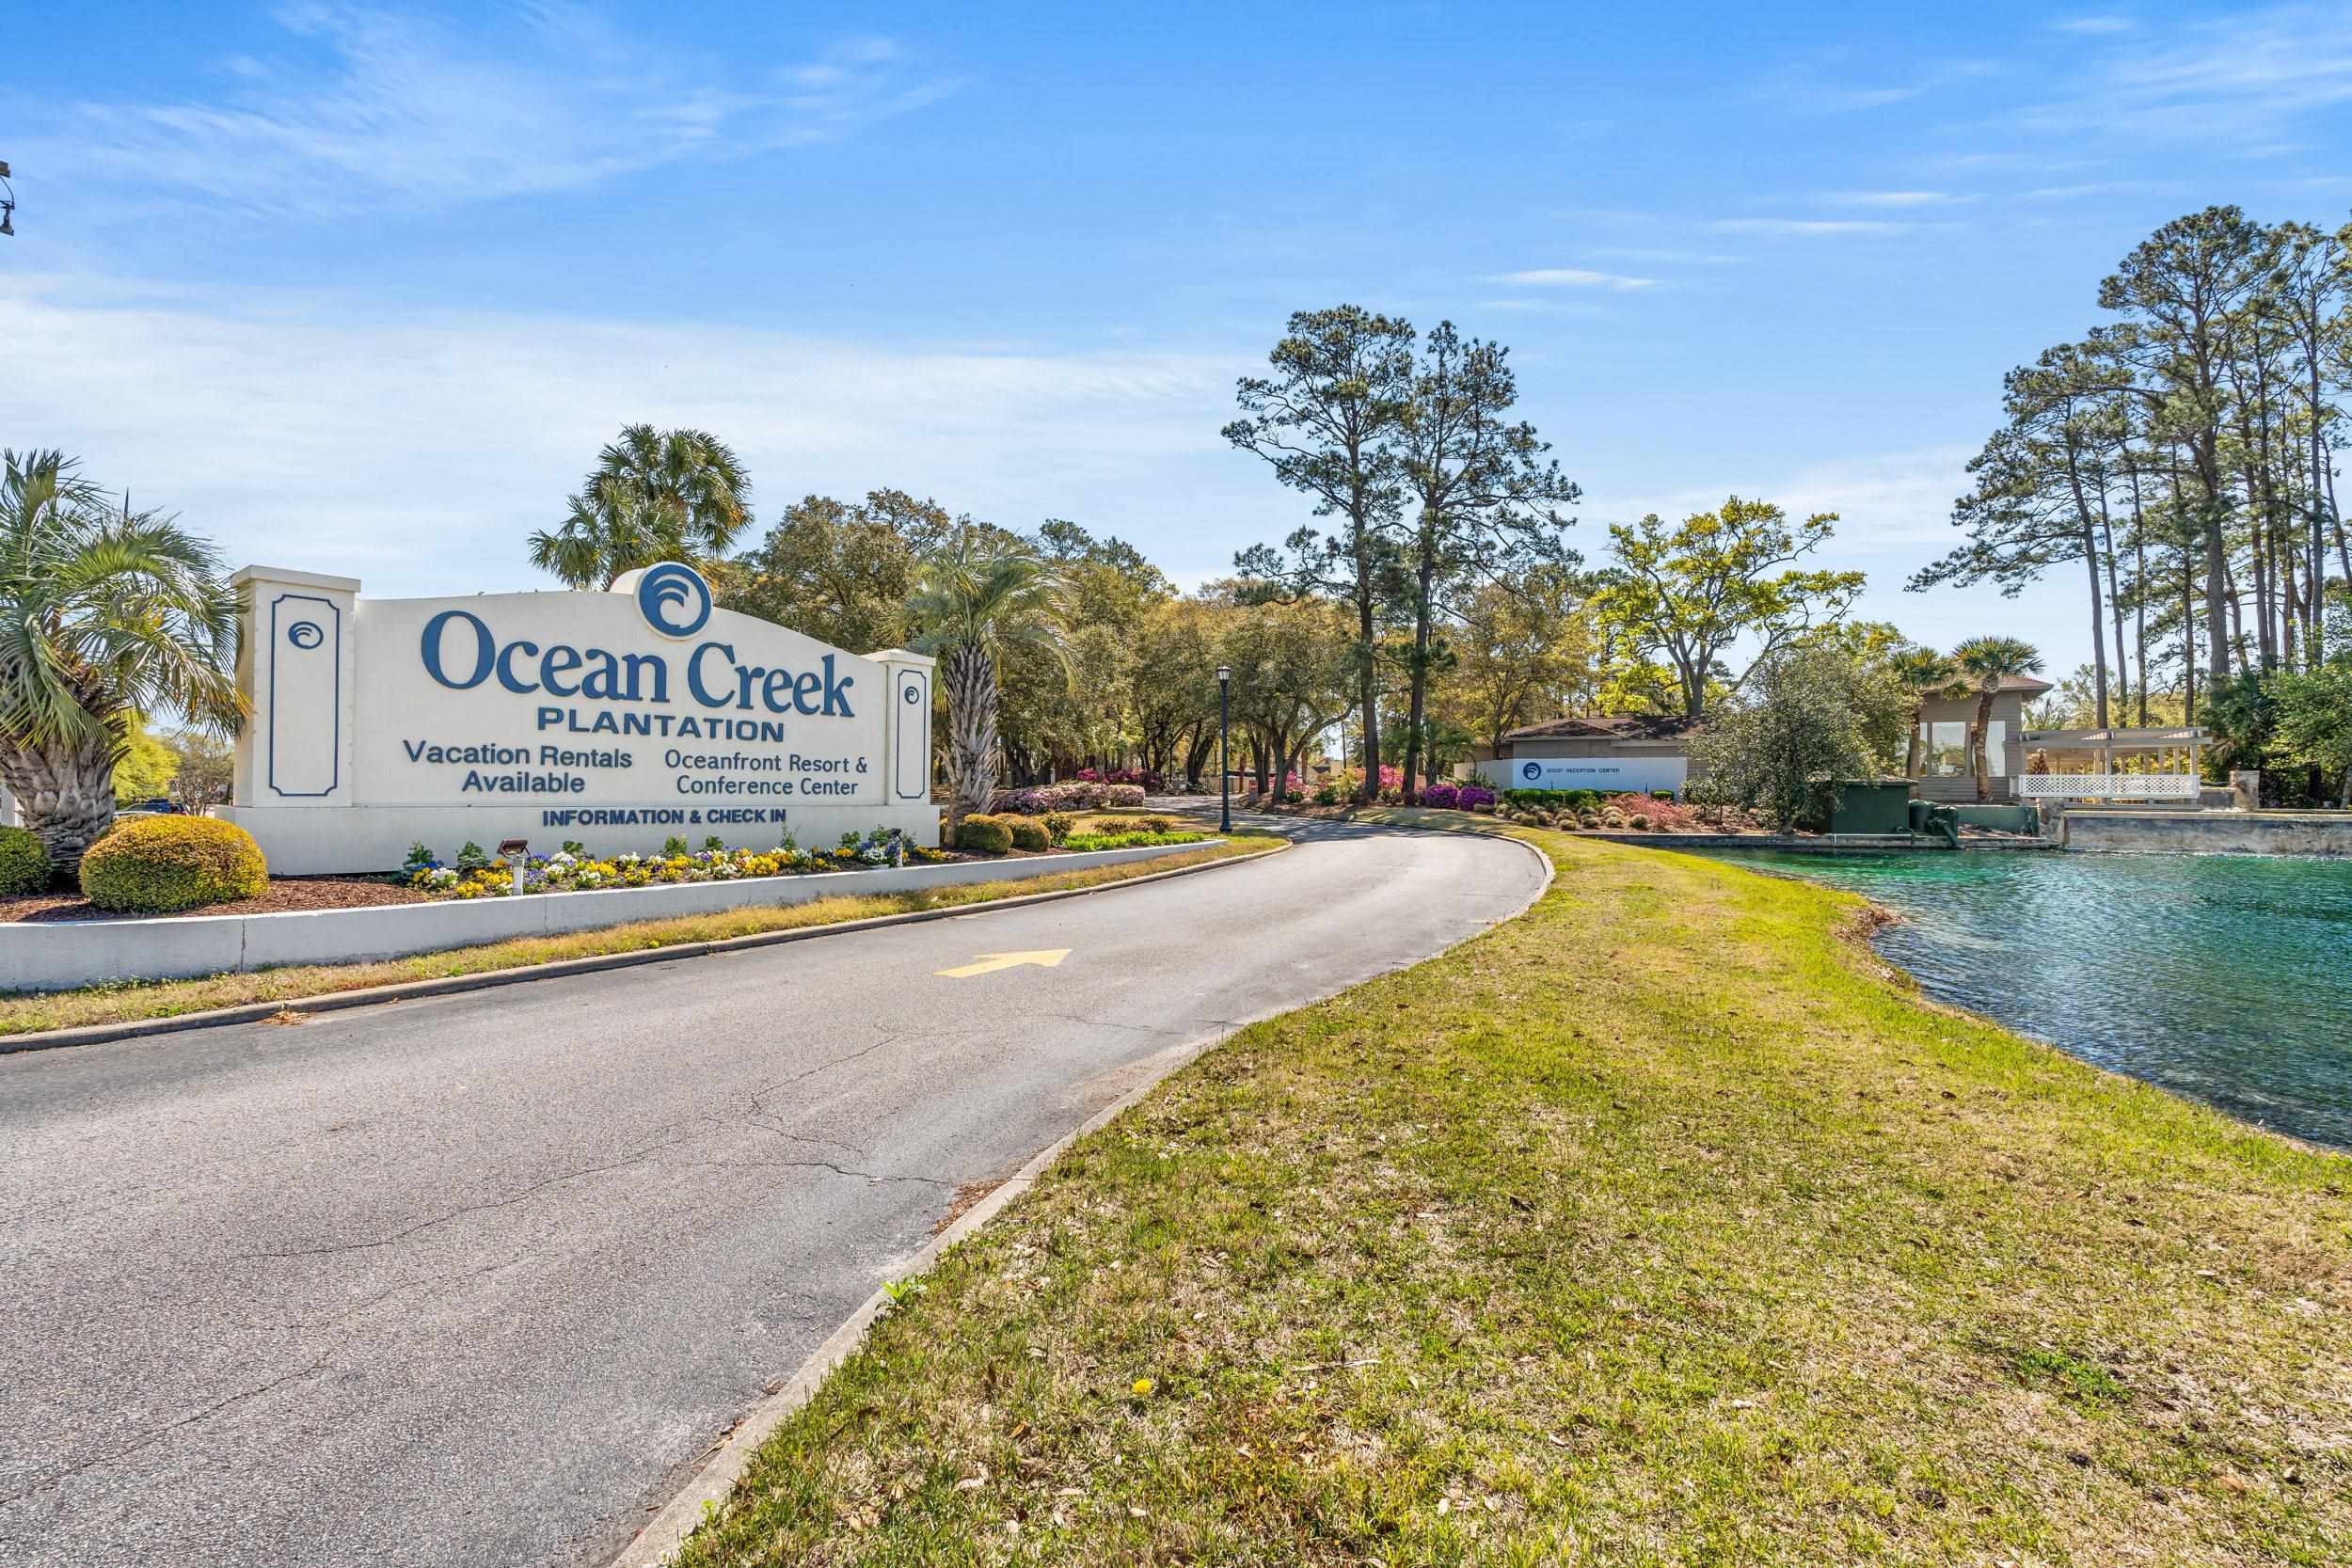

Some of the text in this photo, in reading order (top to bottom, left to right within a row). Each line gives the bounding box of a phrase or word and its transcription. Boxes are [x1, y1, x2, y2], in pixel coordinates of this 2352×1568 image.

[421, 610, 854, 719] Ocean Creek
[537, 707, 785, 743] PLANTATION
[403, 739, 633, 768] Vacation Rentals
[664, 749, 867, 774] Oceanfront Resort &
[461, 769, 586, 794] Available
[676, 774, 859, 796] Conference Center
[542, 805, 787, 827] INFORMATION & CHECK IN
